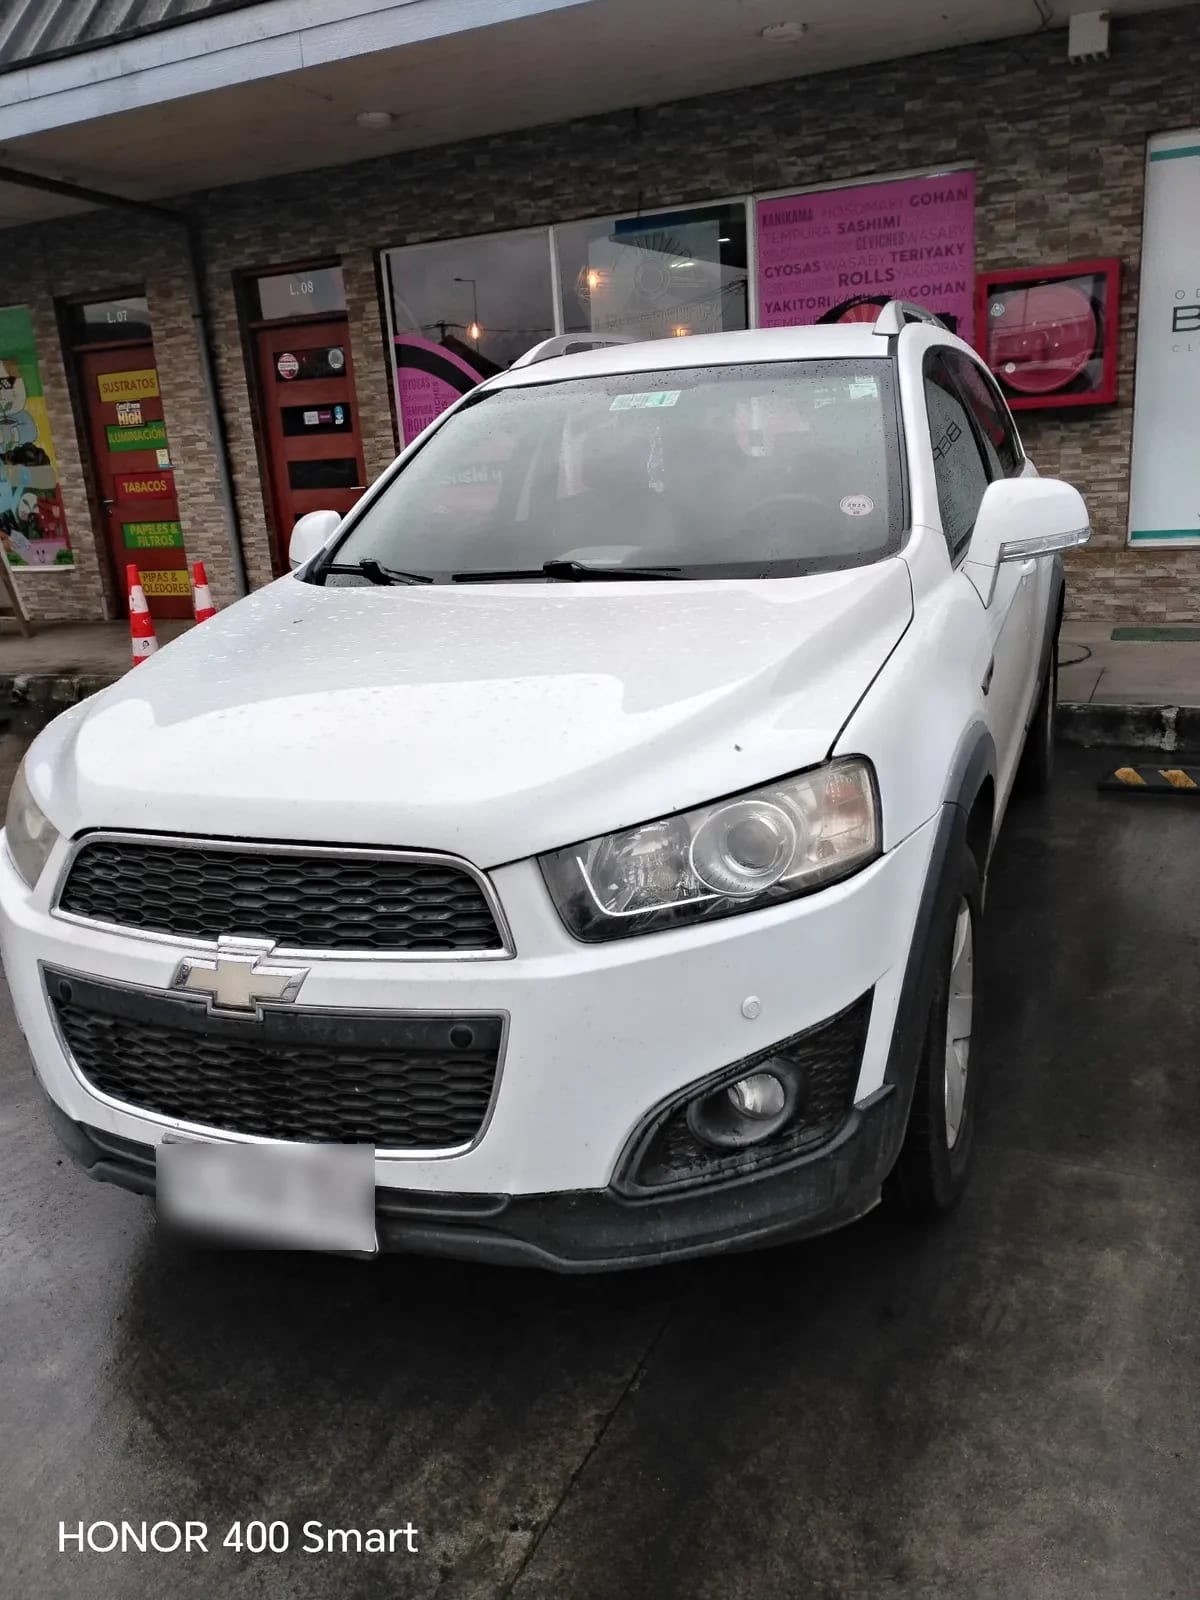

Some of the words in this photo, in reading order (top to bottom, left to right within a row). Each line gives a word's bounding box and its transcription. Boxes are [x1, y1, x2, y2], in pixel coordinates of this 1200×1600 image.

[762, 208, 813, 228] KANIKAMA
[910, 187, 968, 207] GOHAN
[837, 216, 901, 234] SASHIMI
[764, 260, 822, 278] GYOSAS
[889, 243, 965, 263] TERIYAKY
[838, 268, 895, 288] ROLLS
[764, 296, 830, 313] YAKITORI
[908, 280, 966, 298] GOHAN
[102, 377, 155, 394] SUSTRATOS
[118, 411, 142, 425] HIGH
[109, 424, 165, 443] ILUMINACIÓN
[122, 480, 167, 494] TABACOS
[129, 524, 168, 536] PAPELES
[137, 535, 174, 547] FILTROS
[142, 572, 168, 583] PIPAS
[171, 572, 179, 582] &
[143, 583, 190, 595] OLEDORES
